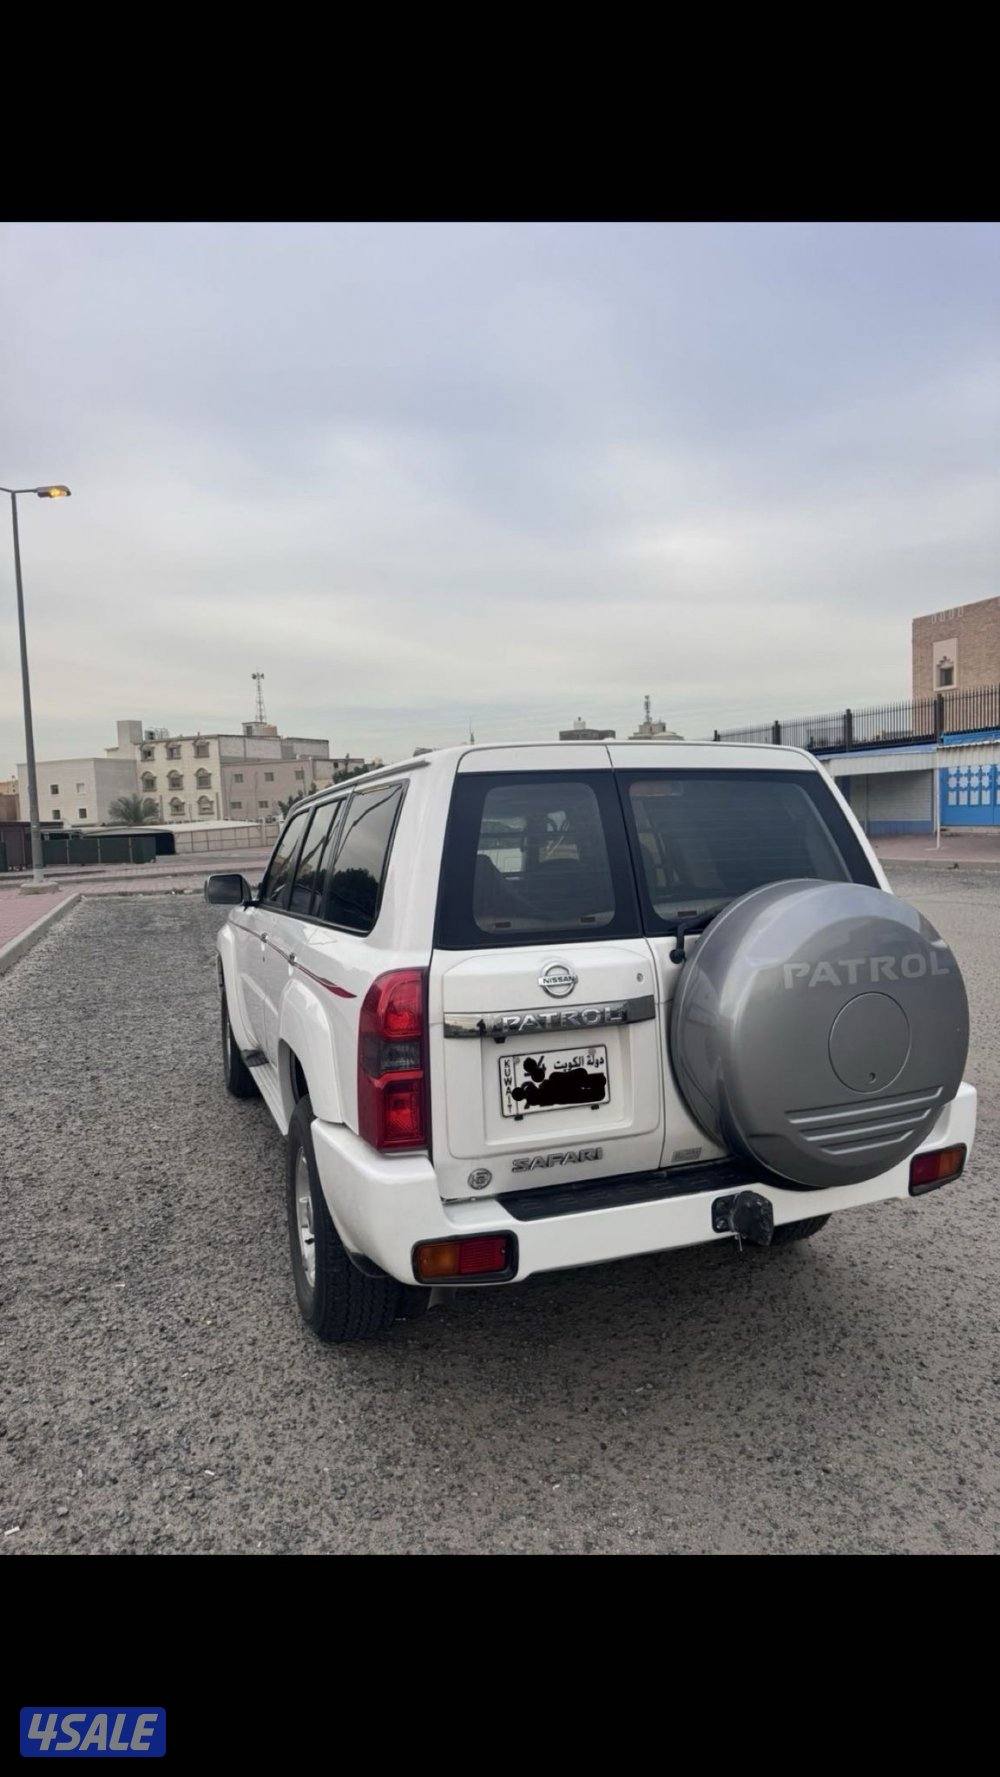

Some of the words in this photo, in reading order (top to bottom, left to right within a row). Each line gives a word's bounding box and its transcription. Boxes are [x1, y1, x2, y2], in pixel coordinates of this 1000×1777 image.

[542, 976, 575, 985] NISSAN
[783, 951, 949, 989] PATROL
[502, 1006, 623, 1033] PATROL
[554, 1056, 584, 1072] الكويت
[586, 1055, 604, 1068] دولة
[503, 1060, 513, 1113] KUWAIT
[511, 1147, 603, 1173] SAFARI
